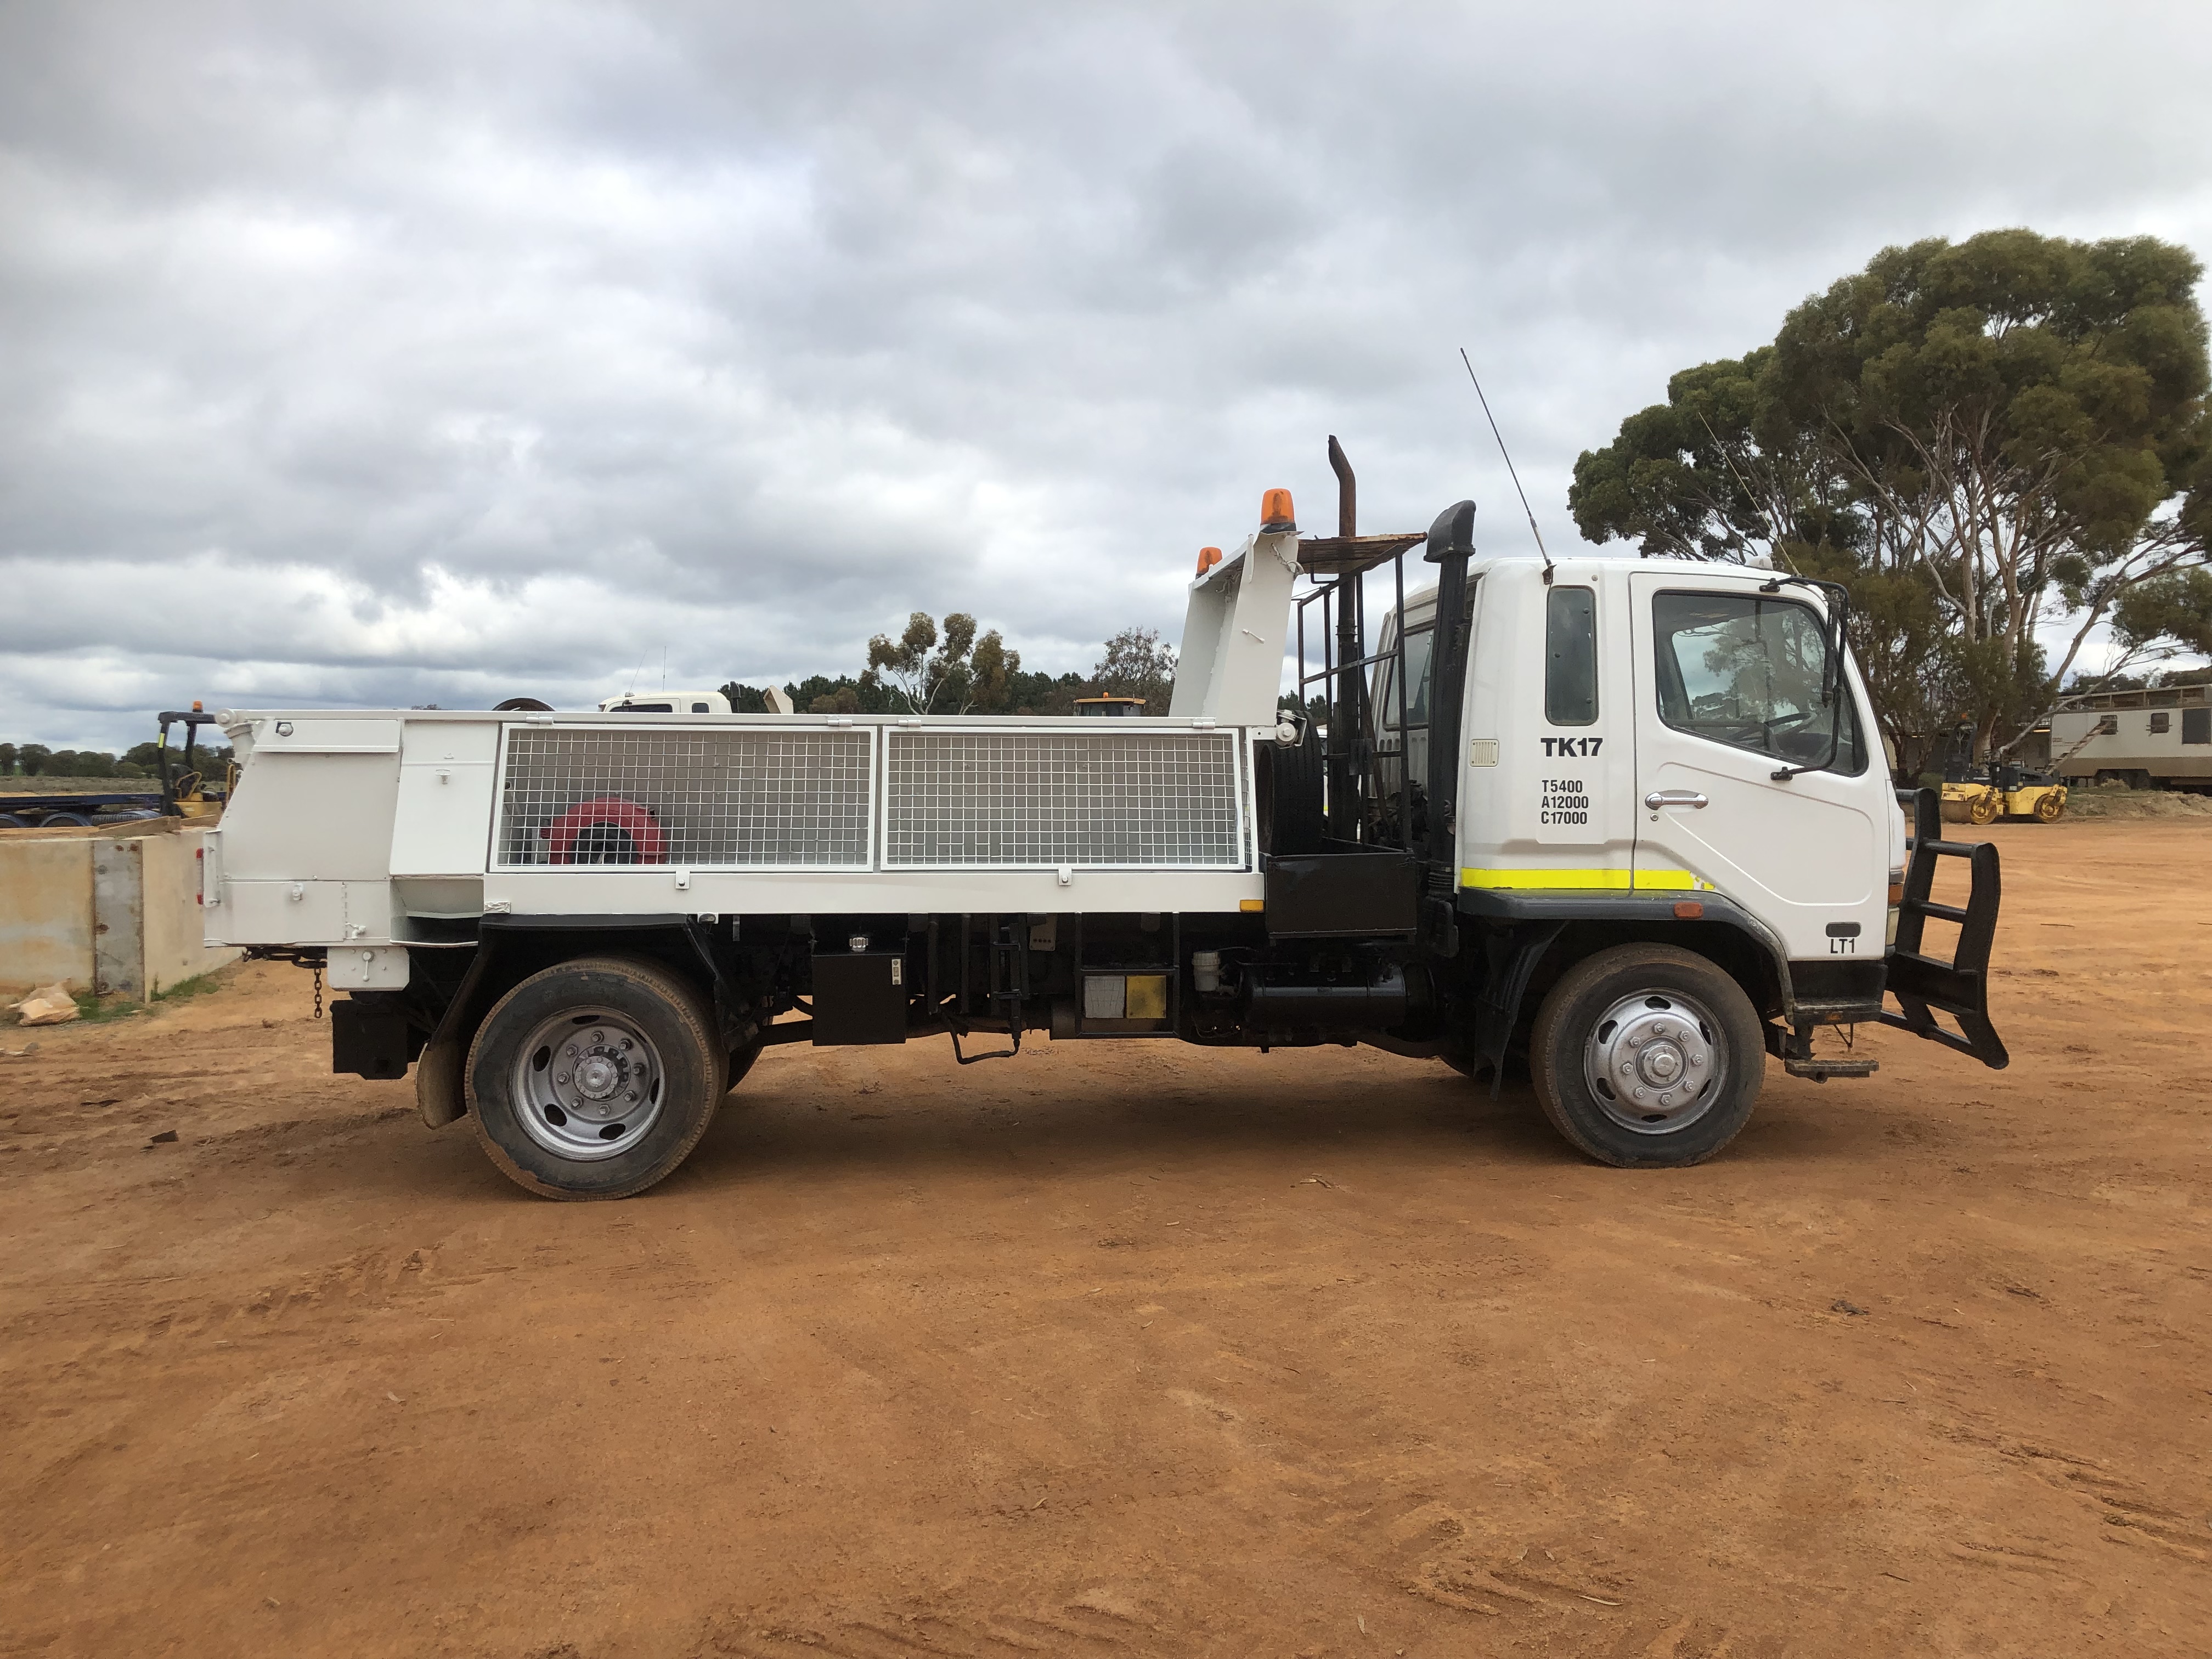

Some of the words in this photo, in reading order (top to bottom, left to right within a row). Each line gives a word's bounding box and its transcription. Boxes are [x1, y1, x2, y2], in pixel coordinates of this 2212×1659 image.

[1541, 737, 1603, 757] TK17
[1542, 780, 1583, 793] T5400
[1541, 795, 1589, 809] A12000
[1541, 811, 1587, 825] C17000
[1830, 938, 1855, 953] LT1
